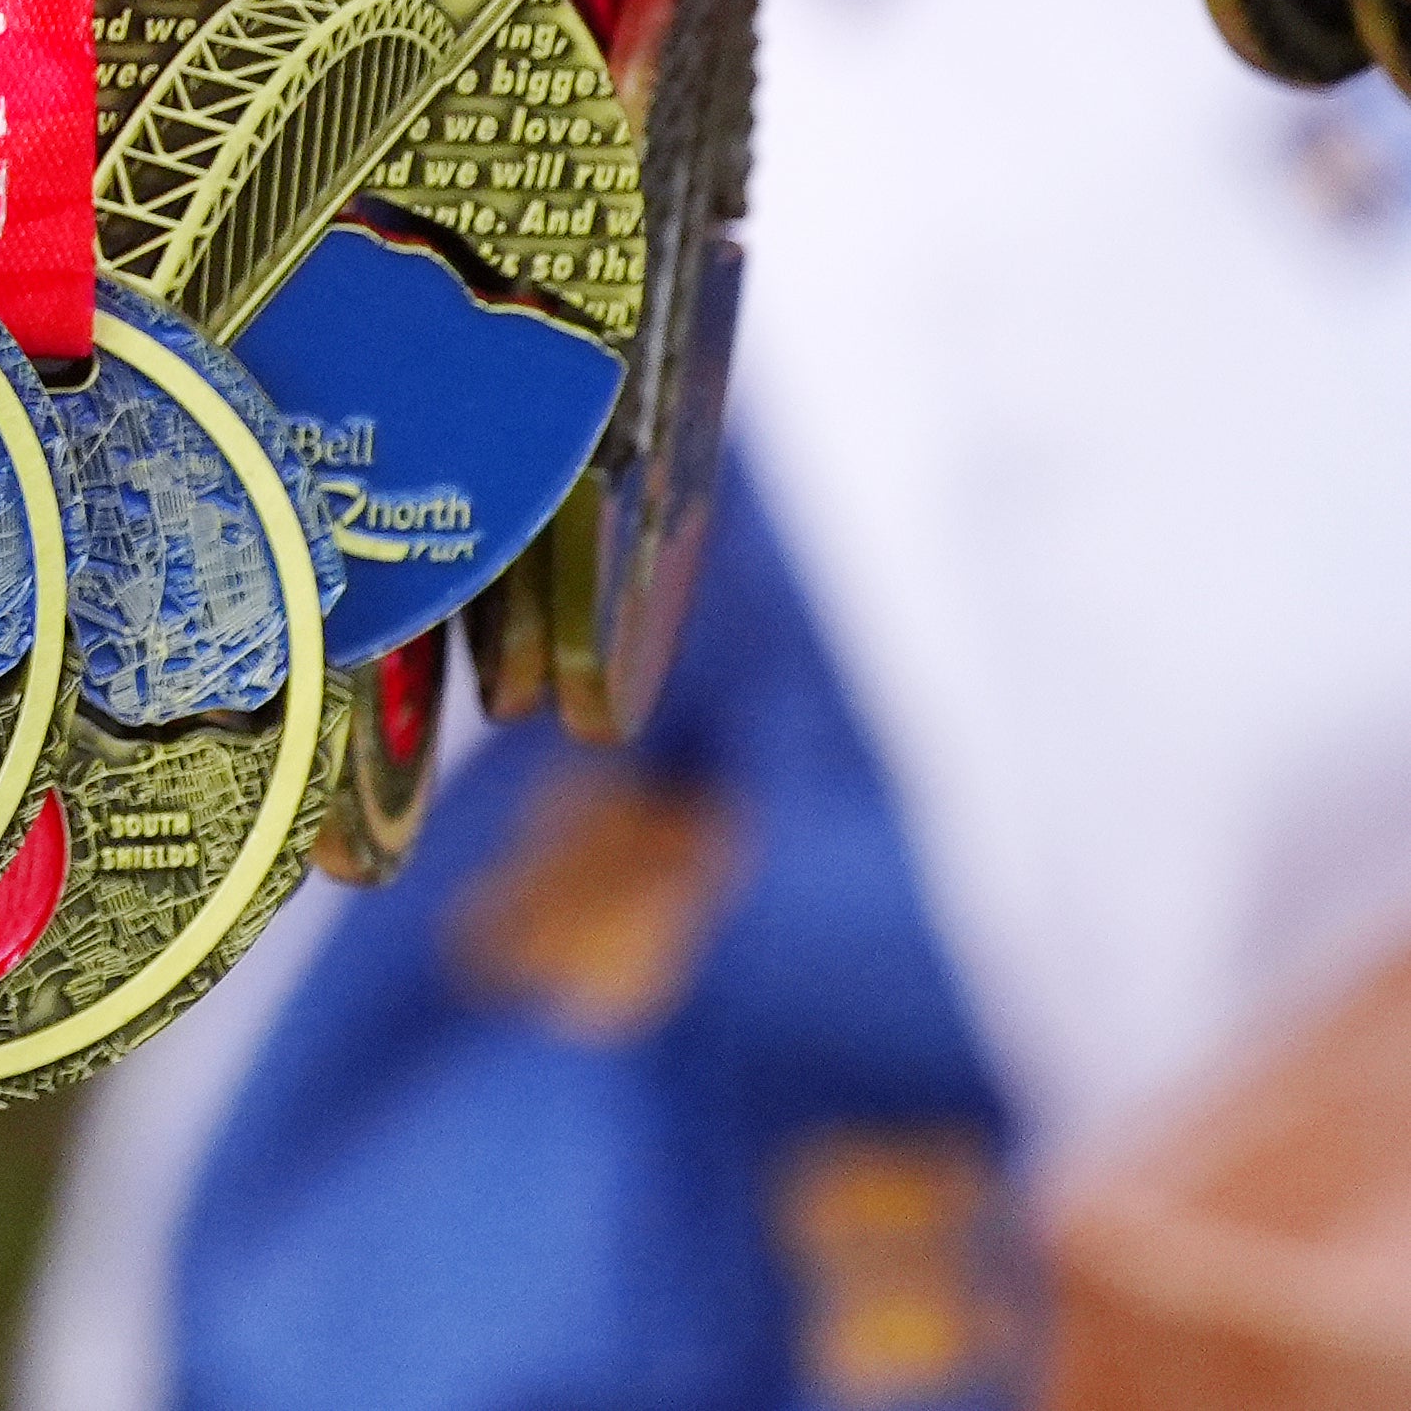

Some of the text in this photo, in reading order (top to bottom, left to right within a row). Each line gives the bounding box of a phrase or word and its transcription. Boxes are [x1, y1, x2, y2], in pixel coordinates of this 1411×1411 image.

[444, 115, 500, 142] we
[509, 105, 604, 145] love.
[424, 160, 479, 189] we
[492, 151, 566, 190] will
[573, 163, 641, 190] run
[518, 198, 598, 237] And
[530, 252, 575, 283] so
[364, 493, 474, 532] north
[109, 812, 192, 839] SOUTH
